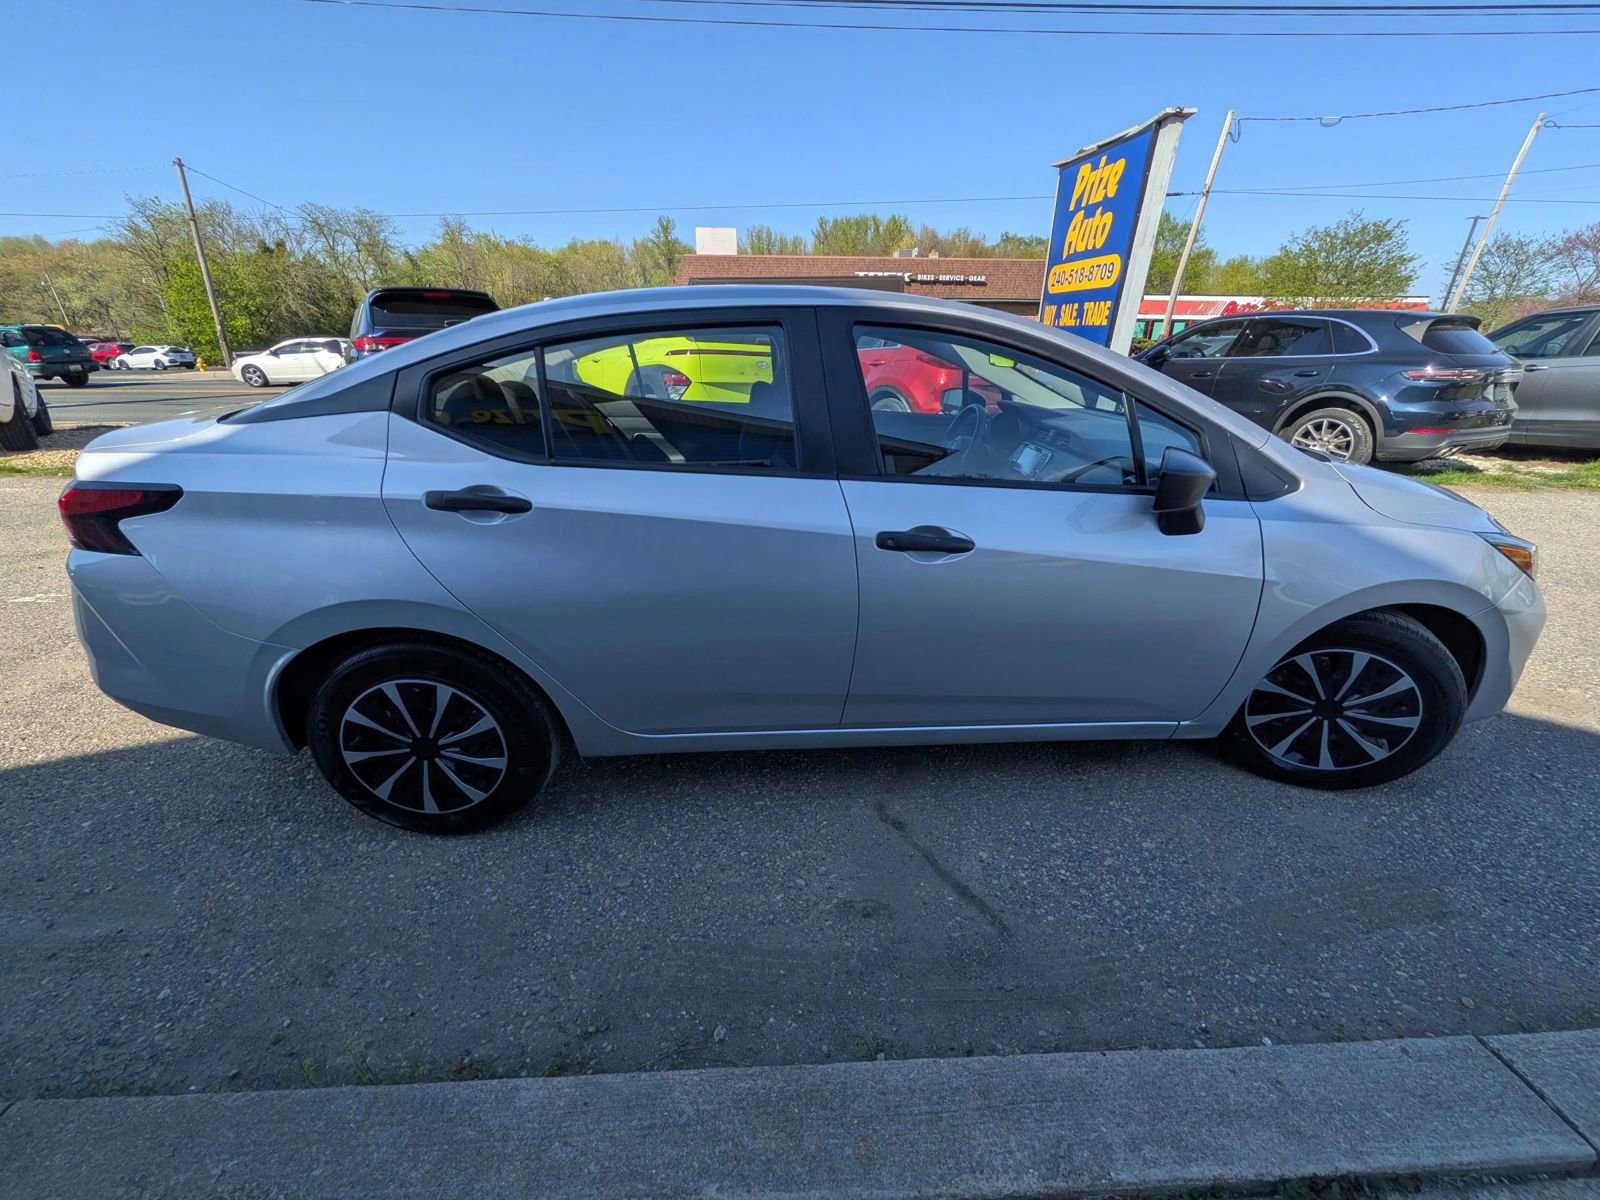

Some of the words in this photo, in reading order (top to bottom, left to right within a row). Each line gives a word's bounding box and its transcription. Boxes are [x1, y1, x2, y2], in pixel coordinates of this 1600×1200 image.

[1069, 155, 1125, 211] Prize
[1062, 206, 1113, 260] Auto
[939, 274, 965, 282] SERVICE
[1051, 262, 1115, 287] 240-518-8709
[1082, 301, 1112, 326] TRADE
